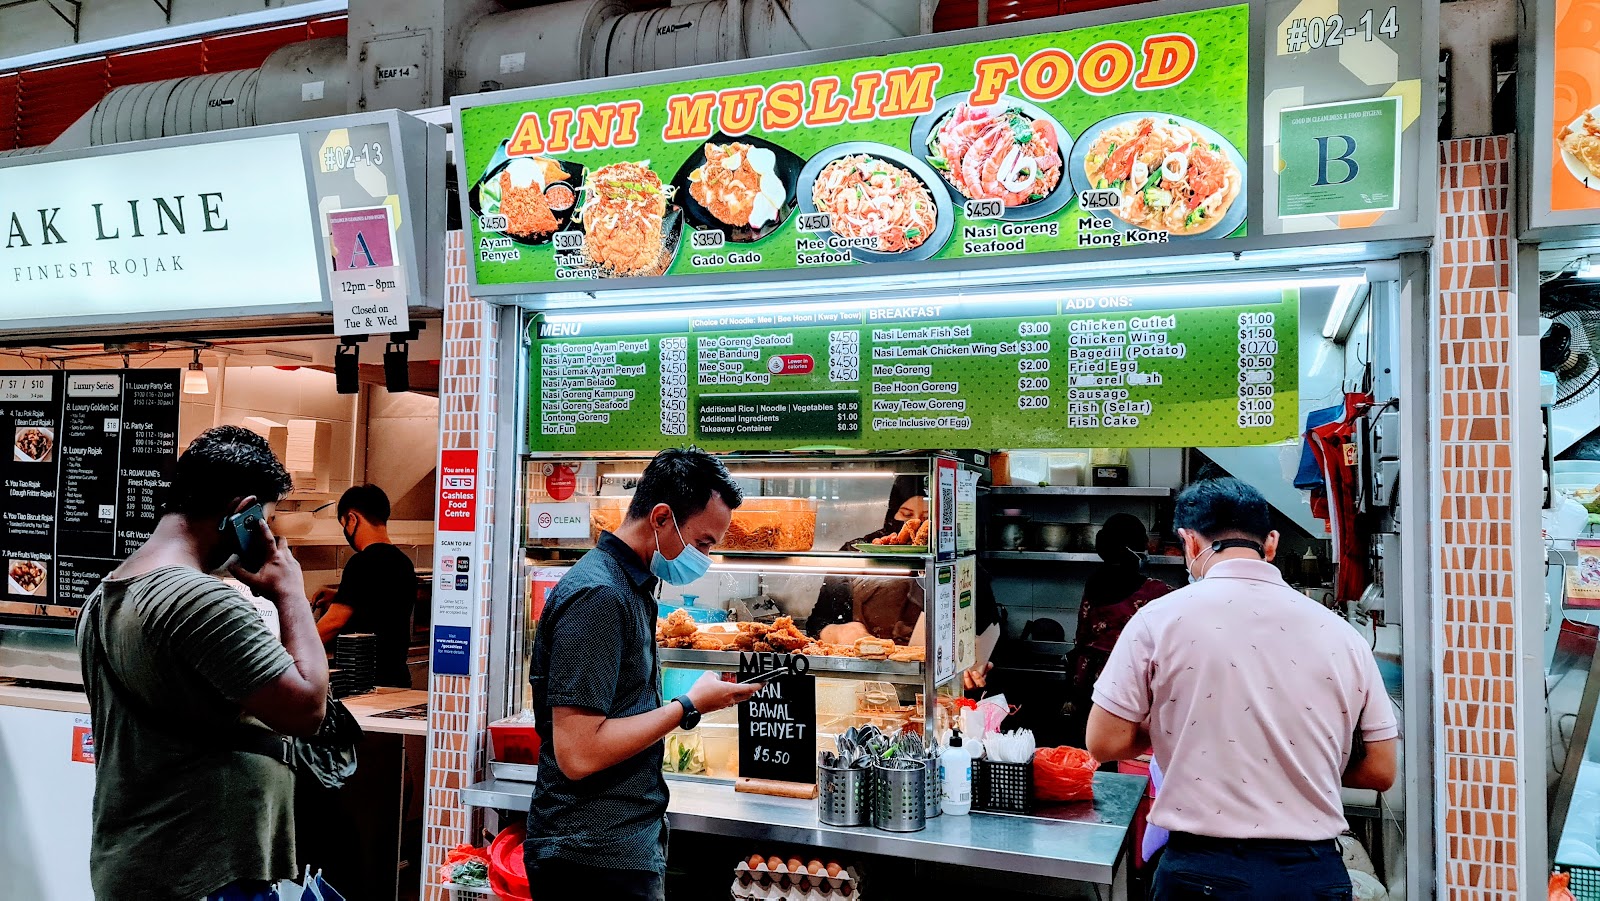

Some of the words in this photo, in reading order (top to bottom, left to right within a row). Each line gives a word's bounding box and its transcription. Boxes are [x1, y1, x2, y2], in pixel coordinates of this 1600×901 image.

[657, 25, 675, 36] KEAD
[1287, 6, 1399, 52] #02-14
[378, 68, 397, 78] KEAF
[399, 67, 410, 77] 1-4
[507, 101, 642, 157] AINI
[663, 63, 943, 141] MUSLIM
[969, 33, 1198, 107] FOOD
[324, 142, 383, 171] #02-13
[1310, 134, 1359, 187] B
[91, 192, 228, 240] LINE
[965, 225, 996, 239] Nasi
[1000, 221, 1058, 237] Goreng
[1079, 218, 1112, 230] Mee
[480, 237, 512, 249] Ayam
[797, 238, 825, 250] Mee
[829, 235, 878, 251] Goreng
[1079, 232, 1121, 247] Hong
[1126, 229, 1168, 243] Kong
[348, 230, 378, 268] A
[965, 239, 1024, 253] Seafood
[481, 249, 519, 262] Penyet
[555, 254, 584, 266] Tahu
[692, 253, 725, 267] Gado
[728, 252, 761, 265] Gado
[797, 250, 851, 265] Seafood
[14, 261, 93, 281] FINEST
[109, 255, 184, 277] ROJAK
[556, 267, 598, 280] Goreng
[342, 281, 366, 294] 12pm
[375, 278, 395, 292] 8pm
[352, 304, 377, 315] Closed
[1066, 299, 1095, 310] ADD
[1099, 296, 1132, 308] ONS:
[870, 306, 942, 319] BREAKFAST
[344, 318, 360, 329] Tue
[365, 318, 373, 328] &
[377, 316, 398, 326] Wed
[1070, 321, 1125, 331] Chicken
[1132, 318, 1174, 329] Cutlet
[1240, 314, 1272, 325] $1.00
[540, 323, 581, 336] MENU
[543, 346, 559, 354] Nasi
[563, 345, 591, 353] Goreng
[594, 343, 616, 352] Ayam
[619, 341, 647, 350] Penyet
[699, 339, 716, 347] Mee
[719, 338, 751, 347] Goreng
[755, 336, 791, 344] Seafood
[699, 351, 716, 359] Mee
[720, 350, 759, 359] Bandung
[874, 348, 894, 357] Nasi
[897, 347, 928, 356] Lemak
[930, 346, 969, 355] Chicken
[972, 345, 997, 355] Wing
[1000, 343, 1016, 353] Set
[1021, 342, 1048, 352] $3.00
[1070, 348, 1122, 359] Bagedil
[1127, 344, 1185, 358] (Potato)
[543, 368, 559, 376] Nasi
[563, 368, 588, 376] Lemak
[591, 367, 613, 376] Ayam
[616, 365, 644, 374] Penyet
[9, 380, 17, 388] $7
[32, 380, 44, 388] $10
[699, 375, 716, 383] Mee
[719, 375, 743, 383] Hong
[745, 373, 769, 383] Kong
[74, 382, 95, 392] Luxury
[1070, 390, 1127, 400] Sausage
[1240, 386, 1272, 396] $0.50
[543, 391, 559, 399] Nasi
[562, 390, 592, 399] Goreng
[594, 390, 634, 399] Kampung
[72, 403, 90, 412] Luxury
[91, 403, 109, 411] Golden
[543, 402, 559, 410] Nasi
[562, 402, 592, 410] Goreng
[874, 401, 899, 411] Kway
[902, 401, 926, 409] Teow
[929, 400, 964, 411] Goreng
[1020, 398, 1048, 407] $2.00
[1070, 403, 1097, 413] Fish
[1104, 401, 1151, 414] (Selar)
[1240, 400, 1272, 410] $1.00
[700, 425, 735, 433] Takeaway
[838, 423, 858, 431] $0.30
[144, 479, 157, 487] Rojak
[445, 478, 471, 486] NETS
[540, 516, 550, 524] SG
[740, 651, 809, 676] MEMO
[750, 701, 794, 721] BAWAL
[751, 721, 806, 740] PENYET
[753, 745, 790, 765] $5.50
